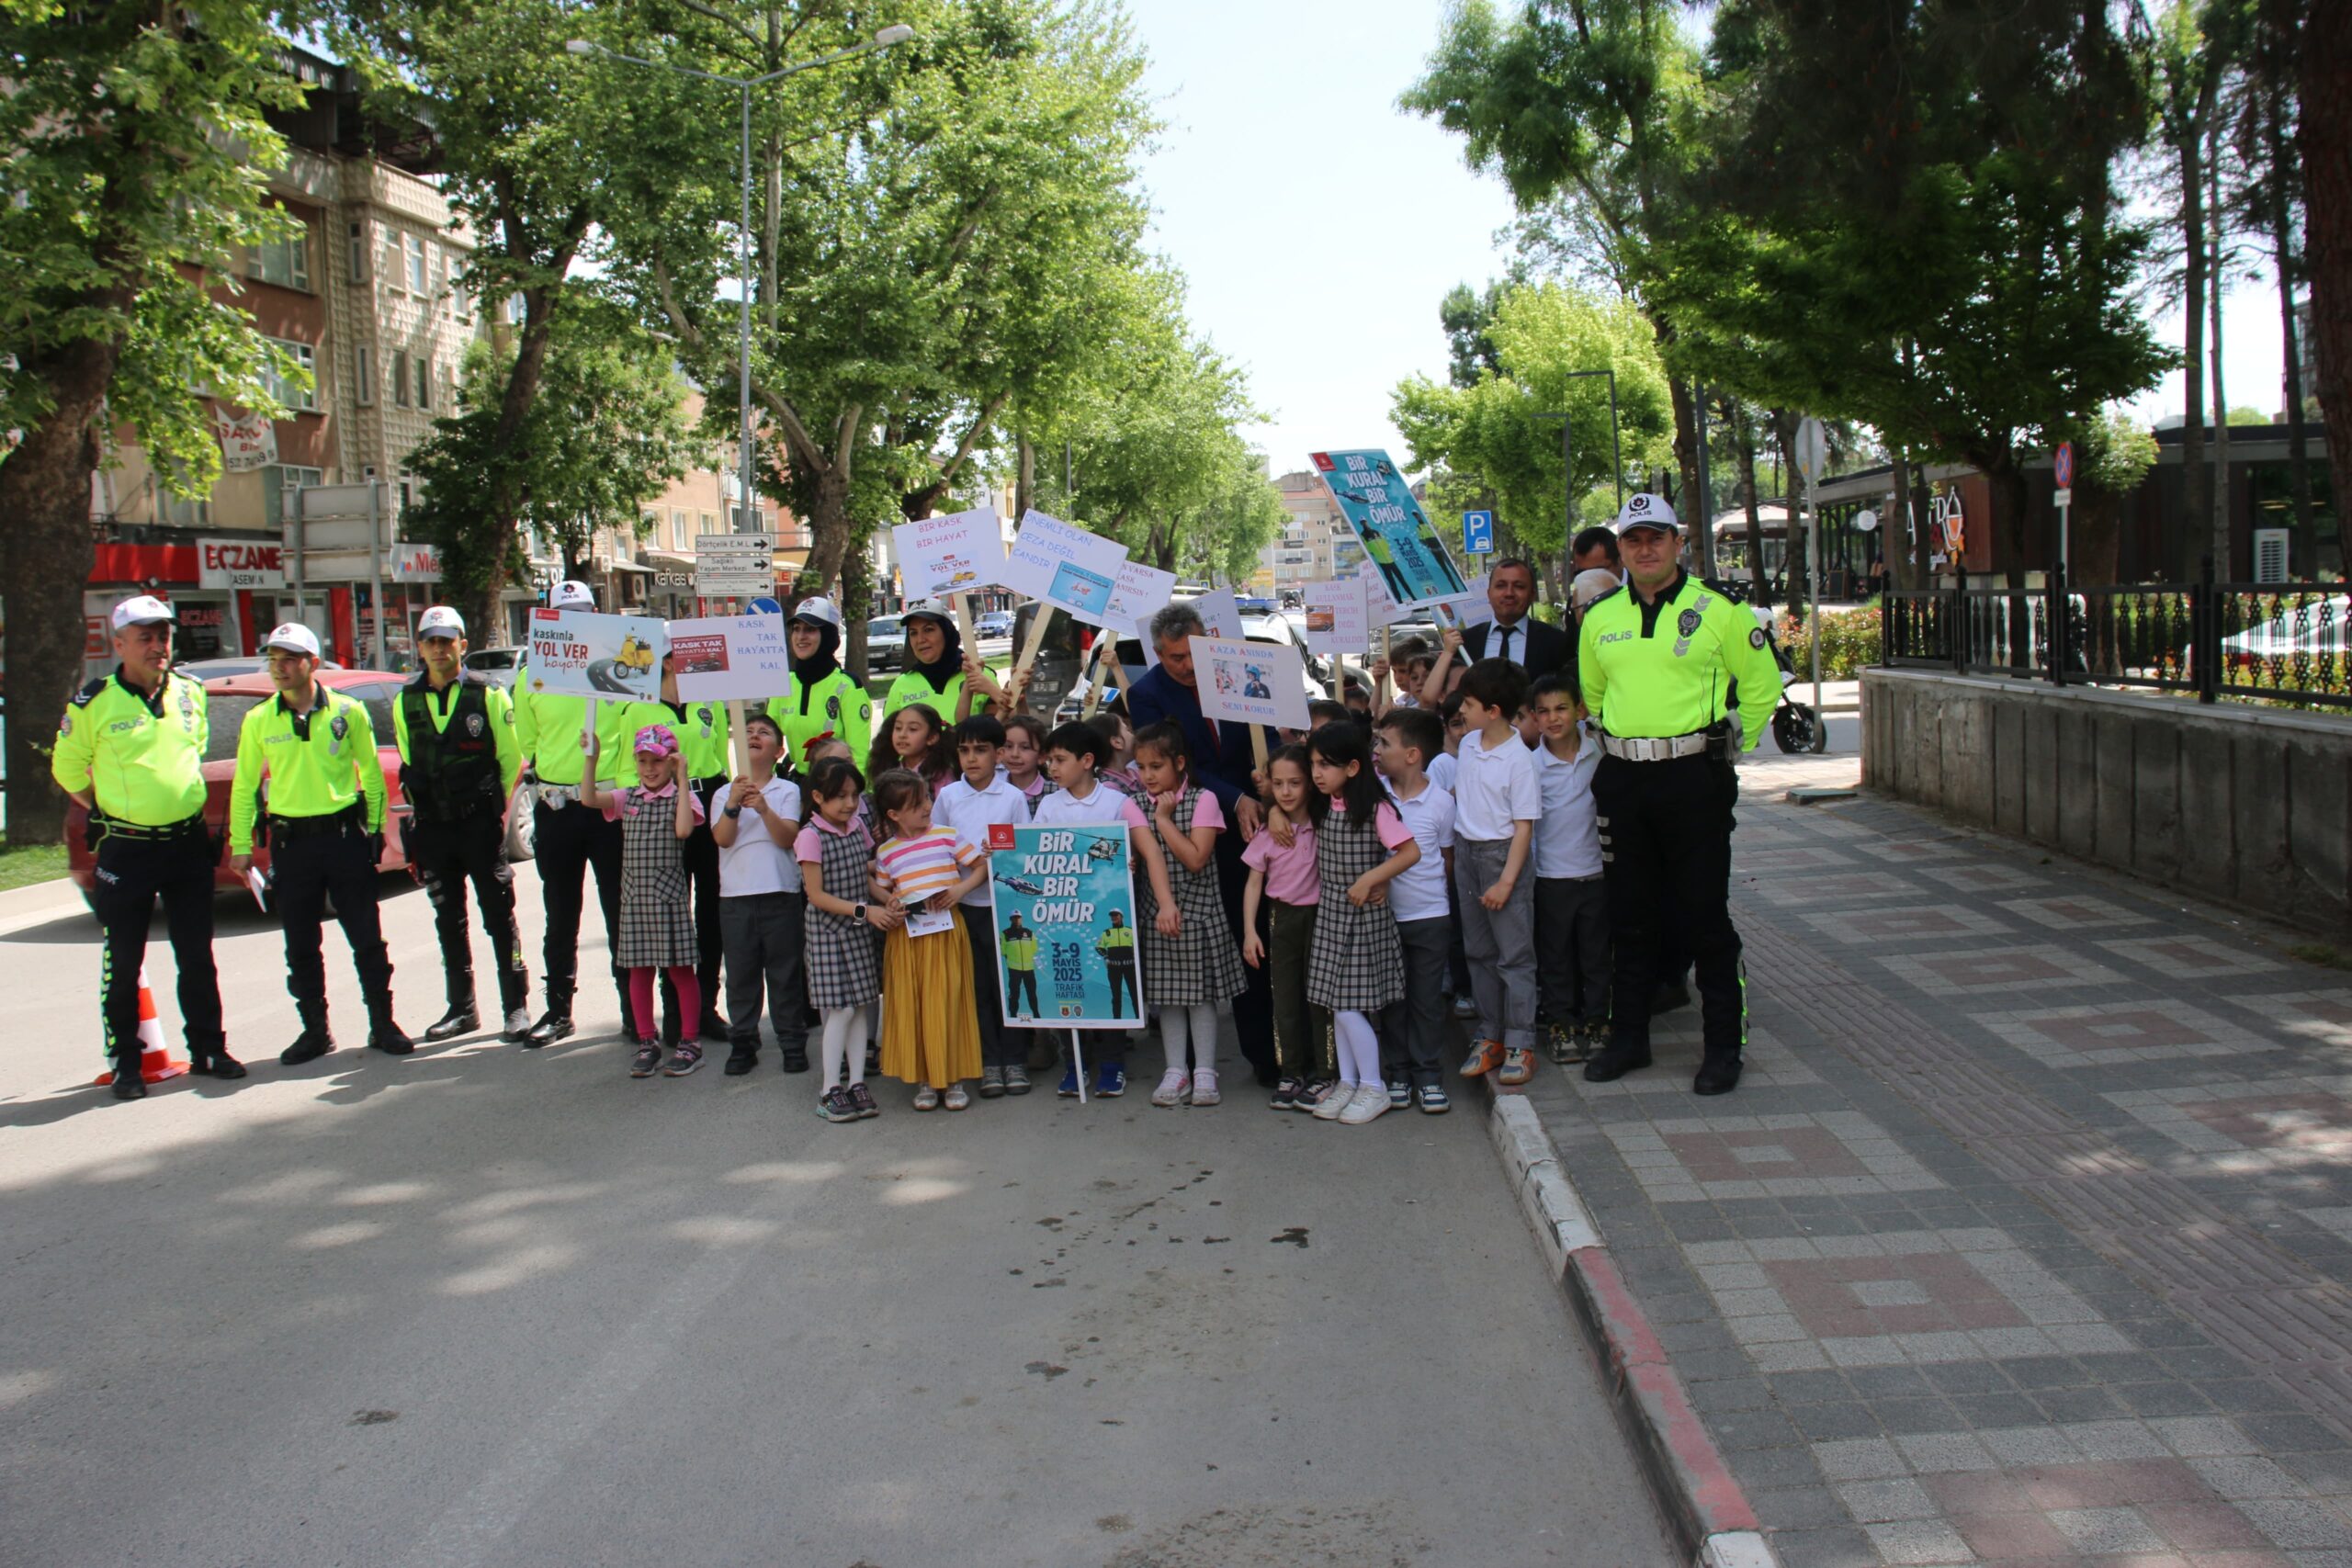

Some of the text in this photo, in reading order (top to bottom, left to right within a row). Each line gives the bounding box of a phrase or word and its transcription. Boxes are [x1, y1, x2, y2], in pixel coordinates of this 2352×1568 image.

[1346, 470, 1388, 489] KURAL
[937, 516, 962, 528] KASK
[1369, 504, 1407, 525] ÖMÜR
[1470, 514, 1485, 536] P
[935, 530, 968, 545] HAYAT
[1065, 529, 1093, 546] OLAN
[205, 544, 282, 570] ECZANE
[654, 568, 686, 586] kafkas
[738, 620, 764, 628] KASK
[534, 628, 574, 641] kaskınla
[534, 641, 588, 660] YOL VER
[673, 641, 701, 649] KASK
[737, 646, 786, 655] HAYATTA
[1209, 645, 1274, 659] KAZA ANINDA
[544, 654, 588, 674] hayata
[761, 661, 781, 670] KAL
[1244, 705, 1275, 716] KORUR
[1023, 853, 1093, 874] KURAL
[1032, 898, 1095, 922] ÖMÜR
[1051, 942, 1080, 957] 3-9
[1053, 967, 1082, 981] 2025
